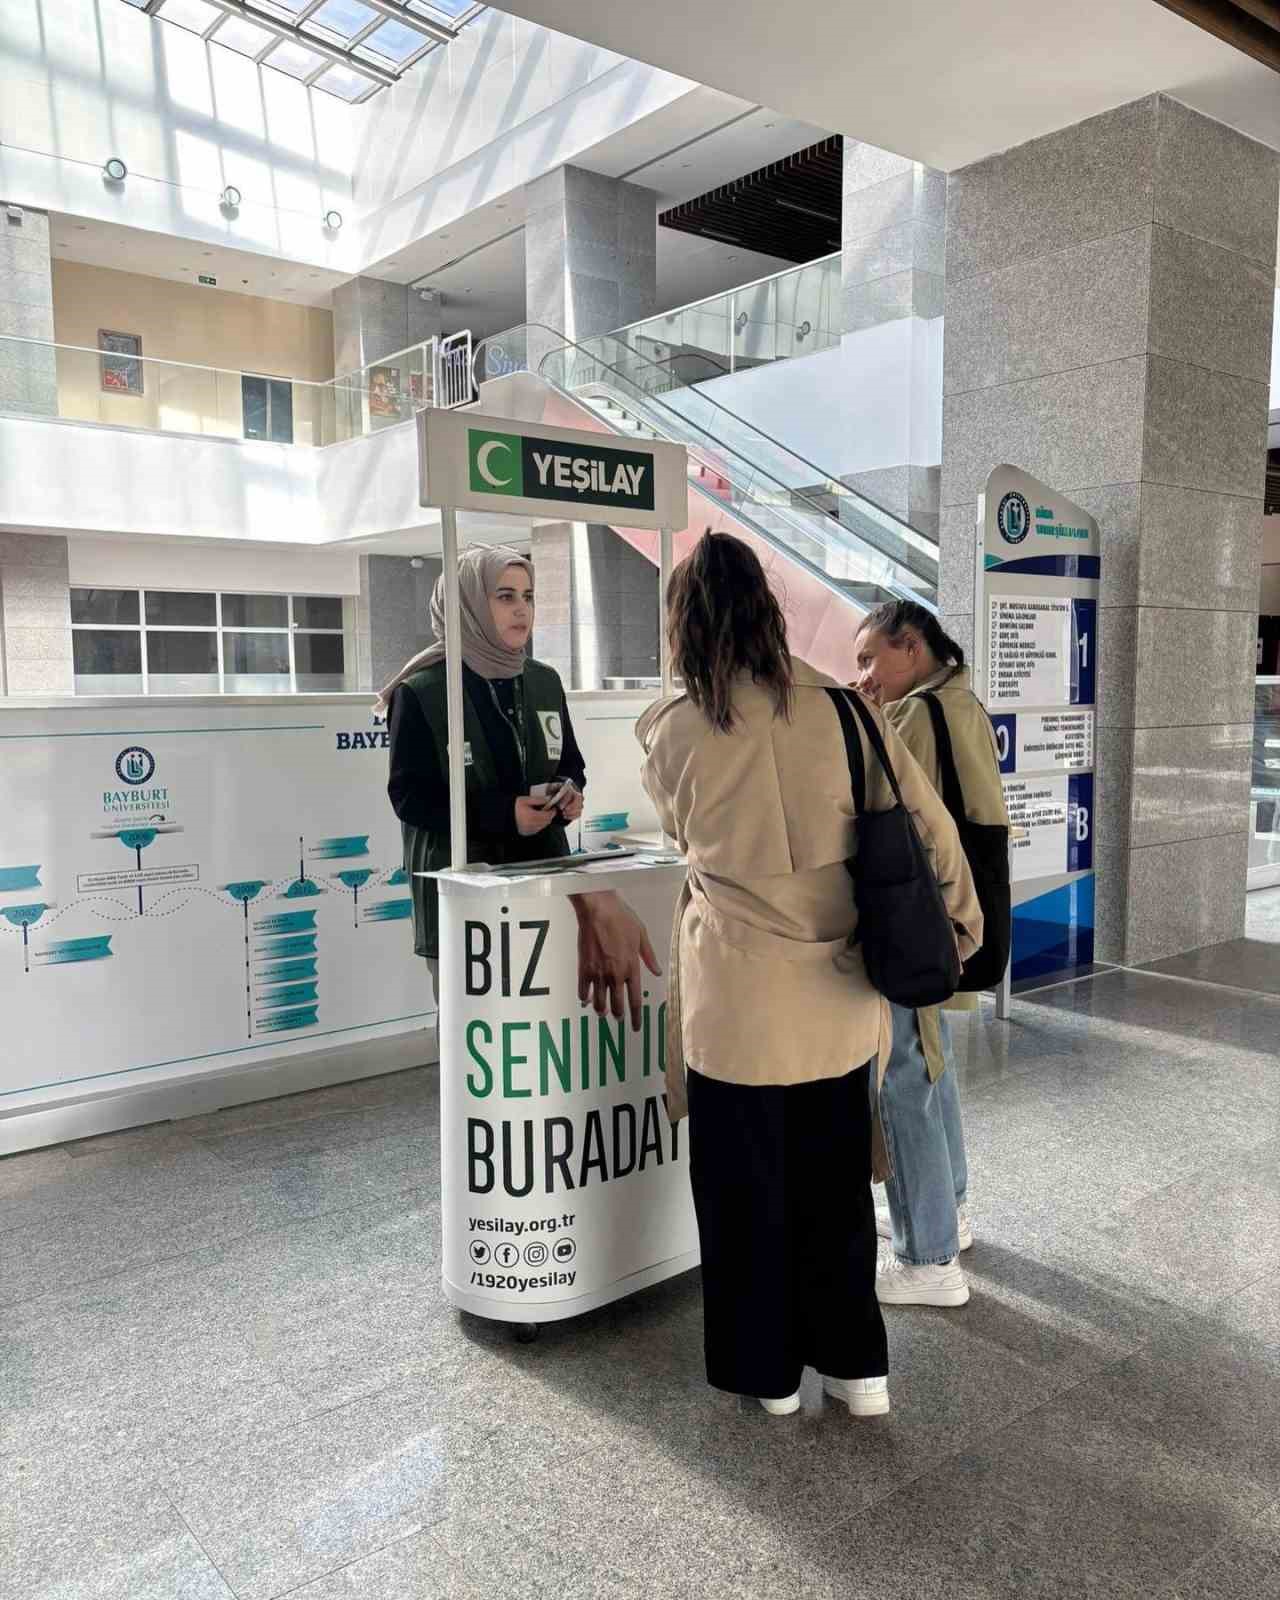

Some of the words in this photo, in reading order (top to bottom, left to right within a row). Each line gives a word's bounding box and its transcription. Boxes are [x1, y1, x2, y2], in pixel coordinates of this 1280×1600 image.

[1078, 632, 1089, 668] 1
[103, 788, 169, 803] BAYBURT
[1076, 806, 1089, 841] B
[464, 905, 551, 998] BİZ
[468, 1213, 576, 1237] yesilay.org.tr
[469, 1270, 577, 1293] /1920yesilay
